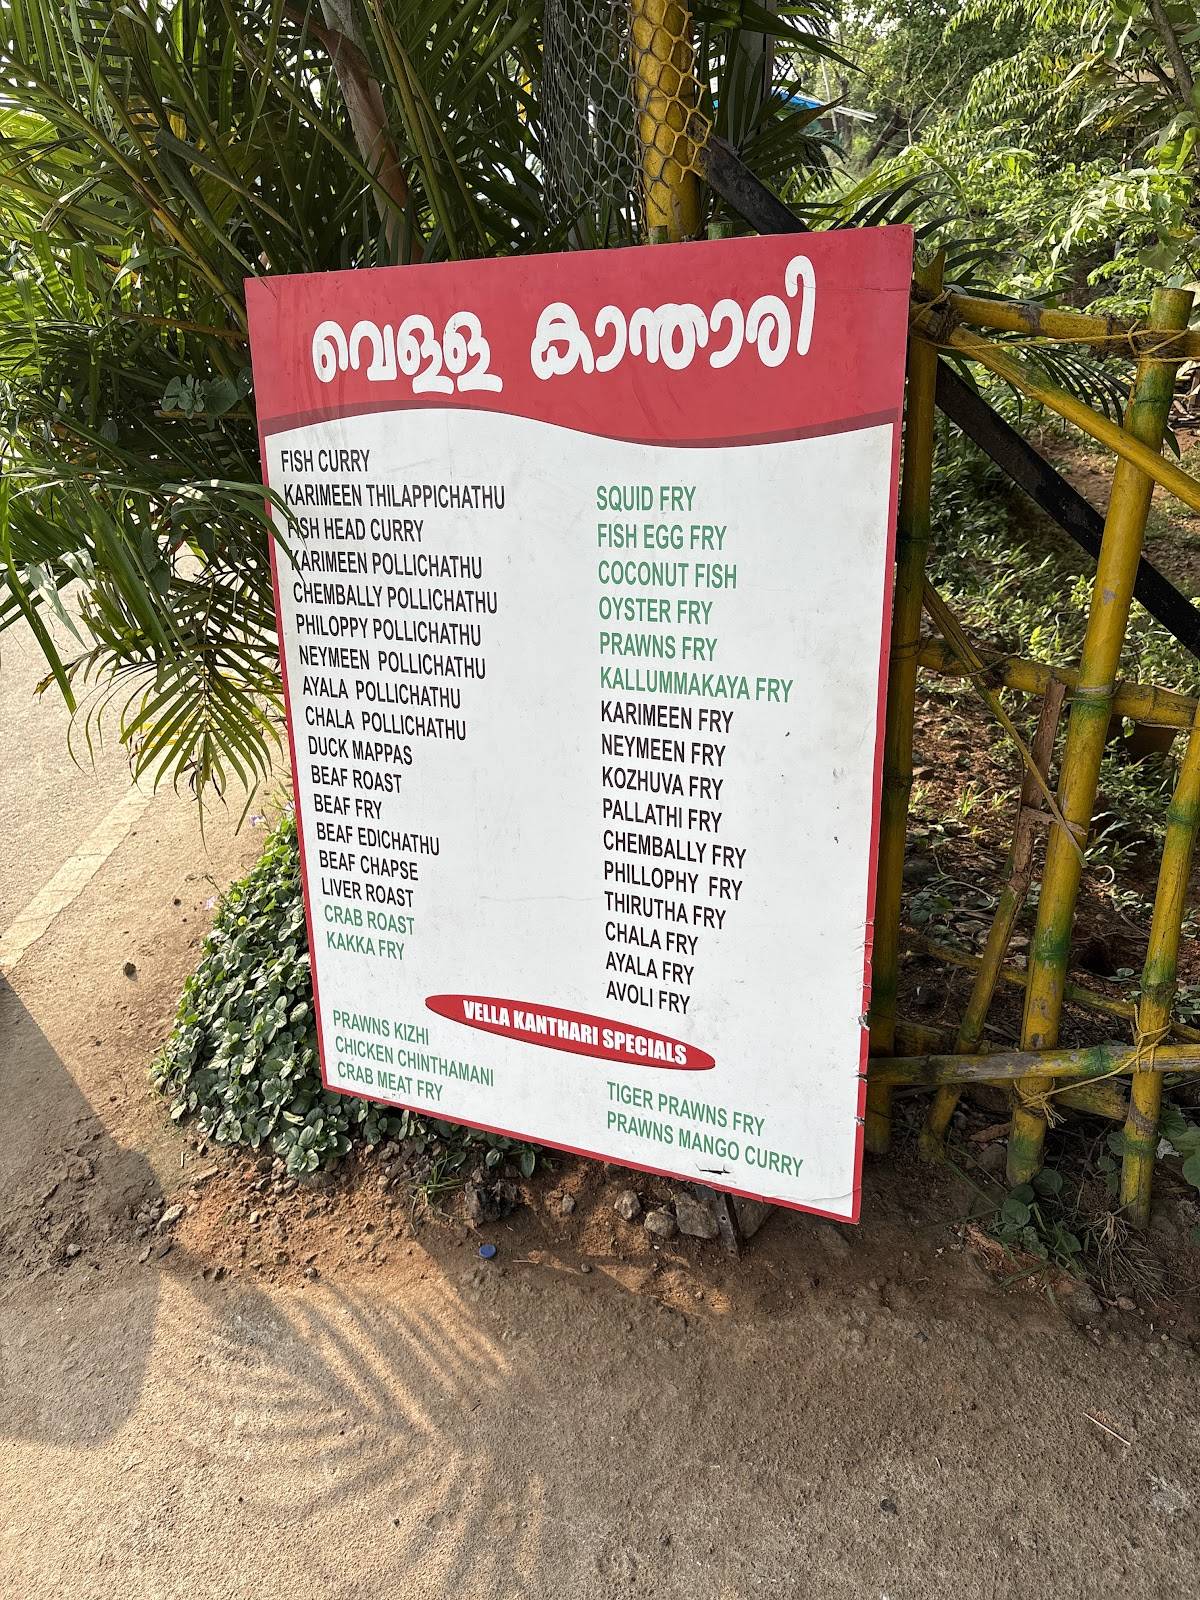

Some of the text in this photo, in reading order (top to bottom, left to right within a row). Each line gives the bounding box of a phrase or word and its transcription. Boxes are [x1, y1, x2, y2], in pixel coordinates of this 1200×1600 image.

[312, 256, 816, 394] വെള്ള കാന്താരി
[281, 450, 370, 472] FISH CURRY
[284, 483, 504, 509] KARIMEEN THILAPPICHATHU
[597, 486, 696, 512] SQUID FRY
[324, 518, 365, 540] HEAD
[371, 519, 423, 542] CURRY
[598, 524, 727, 550] FISH EGG FRY
[372, 553, 481, 579] POLLICHATHU
[599, 561, 736, 588] COCONUT FISH
[294, 582, 497, 614] CHEMBALLY POLLICHATHU
[599, 597, 712, 624] OYSTER FRY
[296, 614, 480, 646] PHILOPPY POLLICHATHU
[600, 632, 717, 661] PRAWNS FRY
[299, 645, 485, 679] NEYMEEN POLLICHATHU
[303, 676, 460, 709] AYALA POLLICHATHU
[601, 667, 793, 702] KALLUMMAKAYA FRY
[306, 706, 465, 740] CHALA POLLICHATHU
[602, 700, 733, 733] KARIMEEN FRY
[308, 736, 412, 765] DUCK MAPPAS
[602, 734, 726, 766] NEYMEEN FRY
[311, 765, 401, 793] BEAF ROAST
[603, 766, 723, 800] KOZHUVA FRY
[314, 794, 381, 819] BEAF FRY
[603, 798, 722, 833] PALLATHI FRY
[317, 822, 439, 855] BEAF EDICHATHU
[604, 830, 746, 869] CHEMBALLY FRY
[319, 850, 418, 880] BEAF CHAPSE
[605, 861, 742, 900] PHILLOPHY FRY
[322, 877, 413, 907] LIVER ROAST
[325, 905, 414, 934] CRAB ROAST
[605, 891, 726, 929] THIRUTHA FRY
[327, 931, 404, 960] KAKKA FRY
[606, 922, 698, 955] CHALA FRY
[606, 951, 694, 985] AYALA FRY
[606, 981, 690, 1014] AVOLI FRY
[333, 1010, 428, 1045] PRAWNS KIZHI
[463, 1000, 686, 1065] VELLA KANTHARI SPECIALS
[336, 1036, 493, 1087] CHICKEN CHINTHAMANI
[338, 1062, 442, 1100] CRAB MEAT FRY
[607, 1082, 764, 1136] TIGER PRAWNS FRY
[608, 1111, 803, 1178] PRAWNS MANGO CURRY
